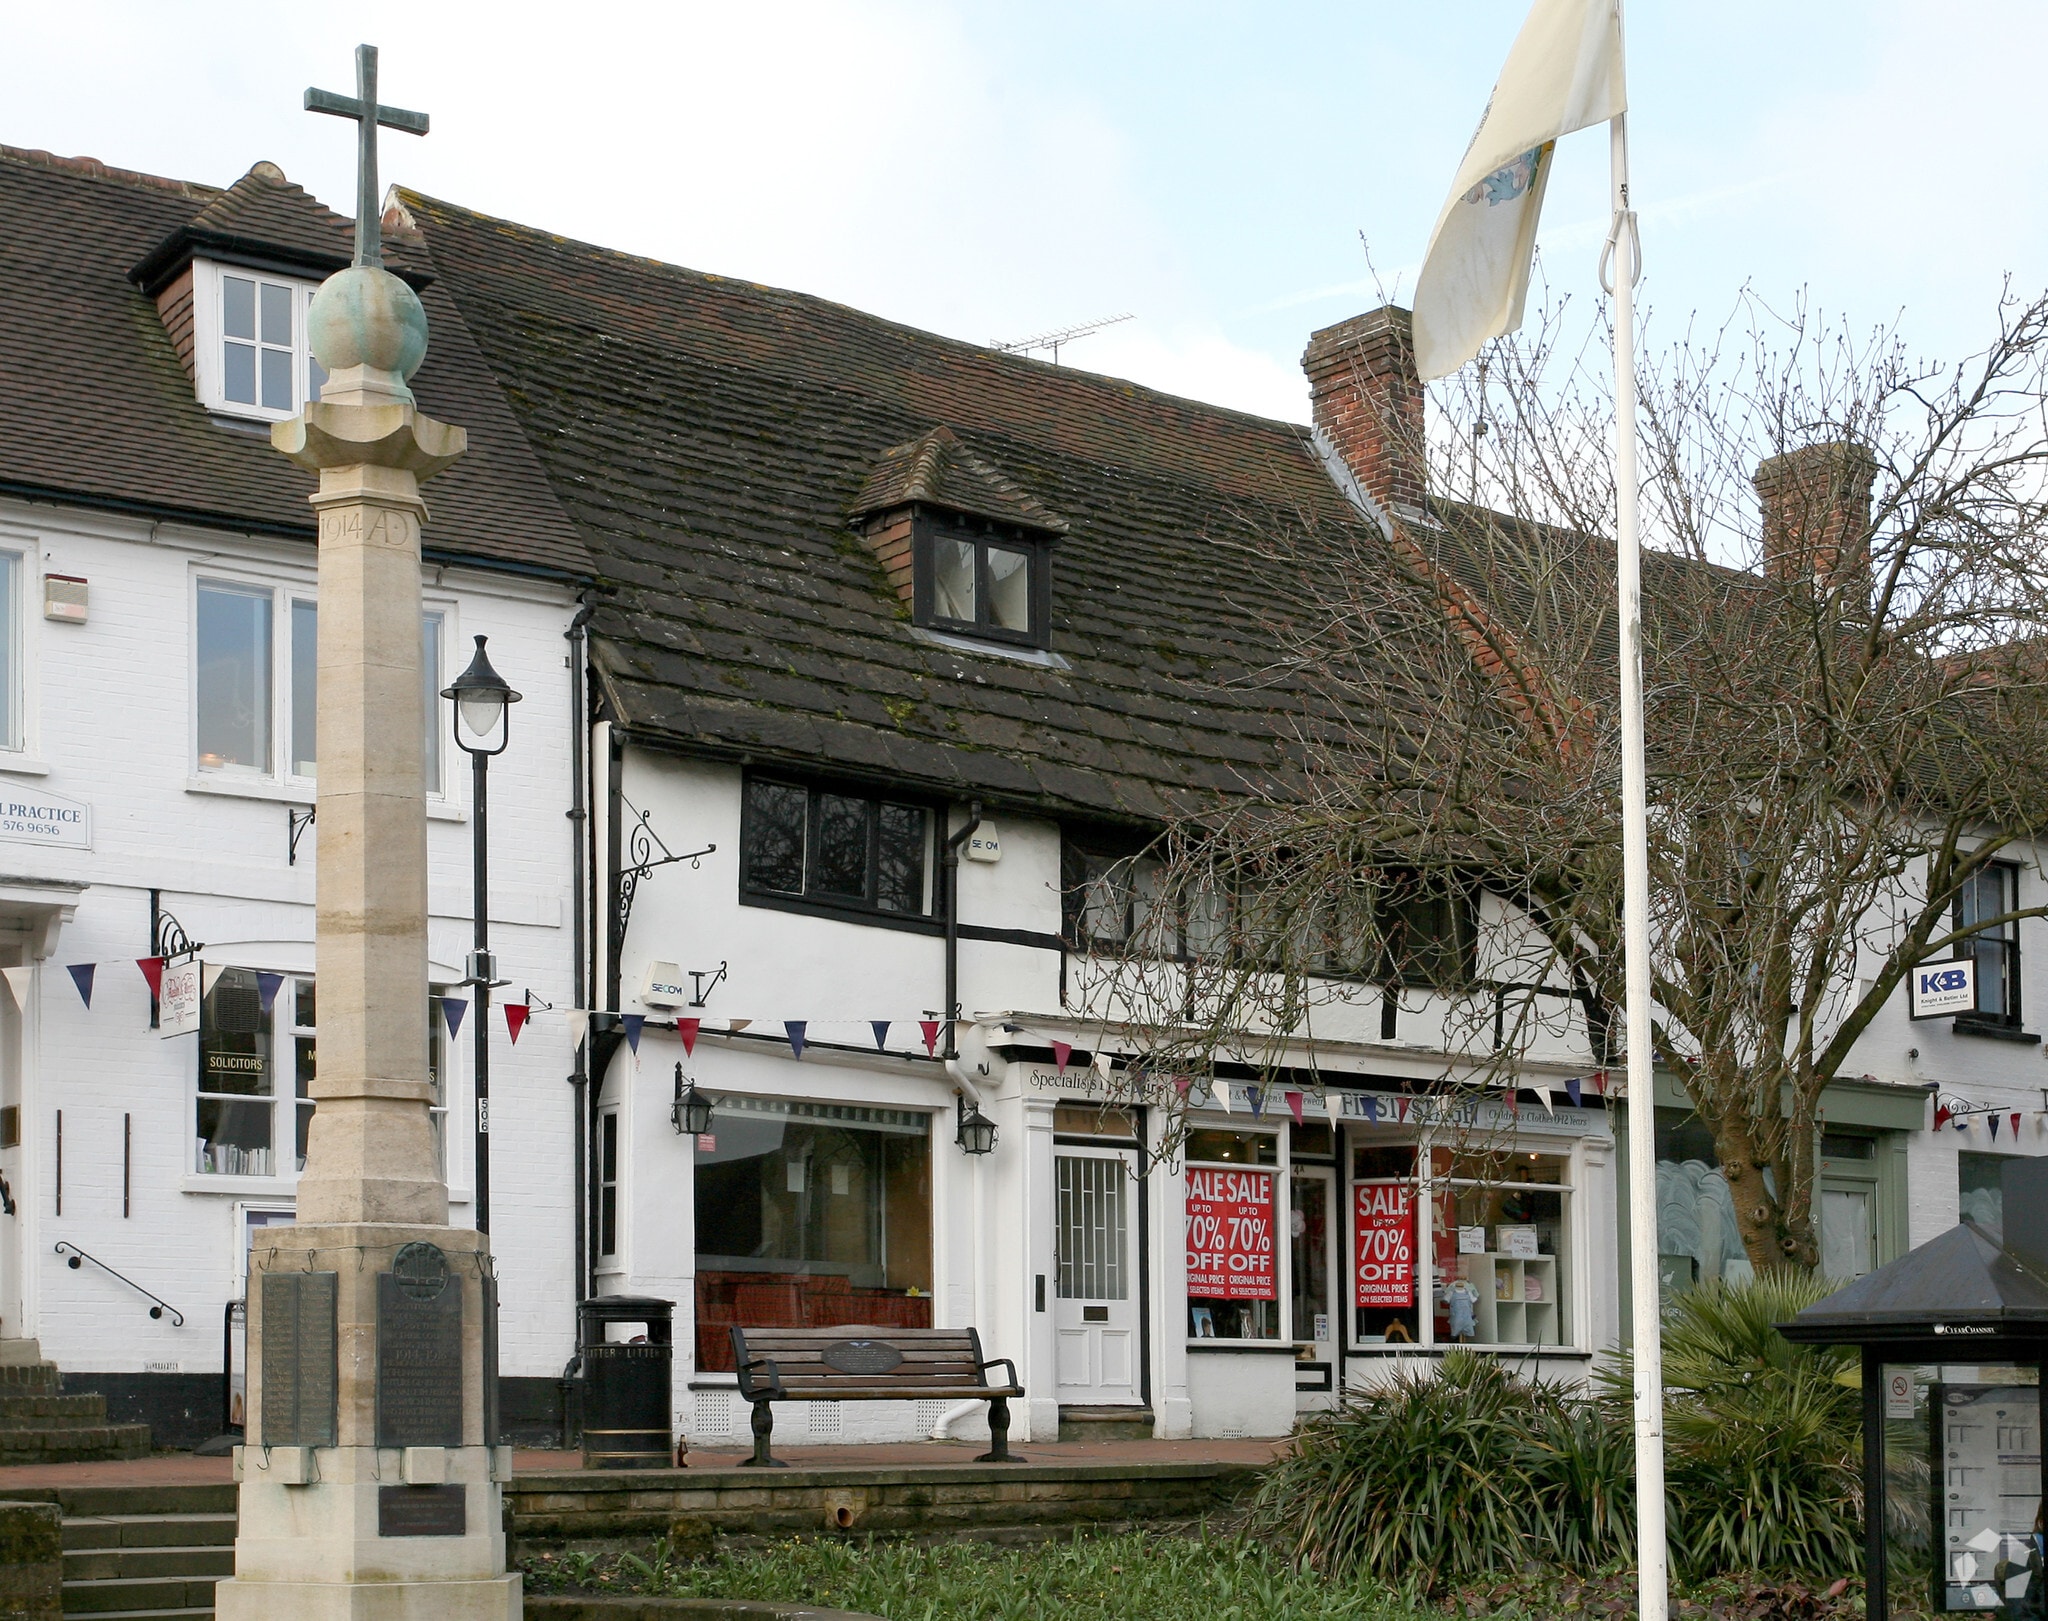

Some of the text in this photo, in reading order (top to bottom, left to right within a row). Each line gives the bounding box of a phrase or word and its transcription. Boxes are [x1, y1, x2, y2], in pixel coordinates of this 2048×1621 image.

[320, 513, 362, 542] 1914
[9, 803, 82, 824] PRACTICE
[3, 820, 60, 835] 576 9656
[972, 839, 998, 850] SEOM
[652, 983, 682, 995] SECOM
[209, 1056, 263, 1071] SOLICITORS
[1526, 1111, 1553, 1124] Clothes
[1569, 1115, 1587, 1127] Years
[1226, 1172, 1269, 1204] SALE
[1191, 1204, 1212, 1213] UP TO
[1358, 1187, 1409, 1217] SALE
[1239, 1206, 1258, 1215] UP TO
[1186, 1215, 1225, 1251] 70%
[1228, 1217, 1270, 1252] 70%
[1360, 1229, 1409, 1261] 70%
[1186, 1251, 1225, 1271] OFF
[1228, 1253, 1270, 1272] OFF
[1359, 1263, 1409, 1281] OFF
[1209, 1275, 1225, 1285] PRICE
[1229, 1274, 1271, 1286] ORIGINAL PRICE
[1190, 1286, 1224, 1295] SELECTED ITEMS
[1230, 1286, 1271, 1296] ON SELECTED ITEMS
[1359, 1284, 1409, 1294] ORIGINAL PRICE
[1360, 1295, 1408, 1303] ON SELECTED ITEMS
